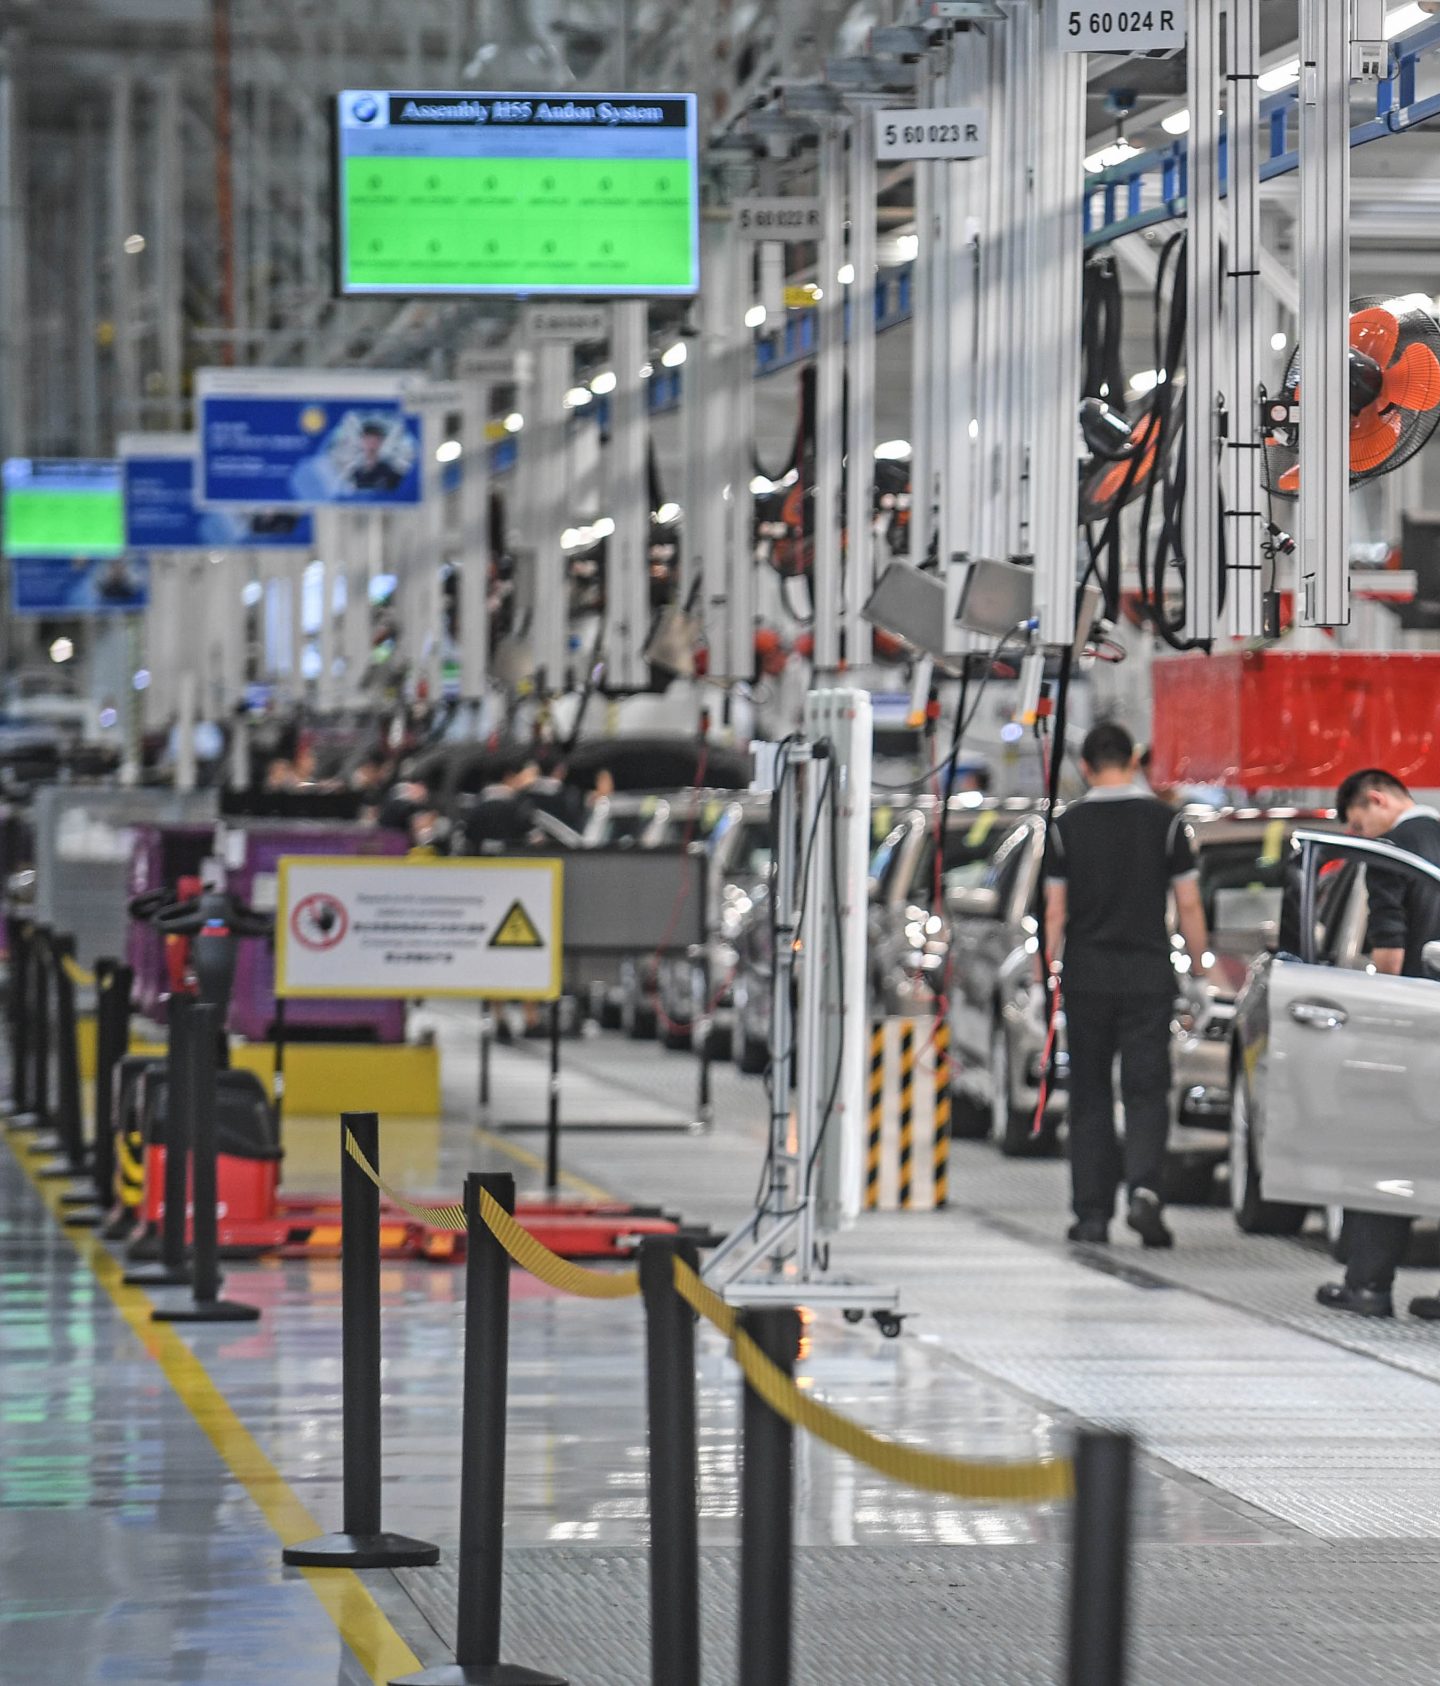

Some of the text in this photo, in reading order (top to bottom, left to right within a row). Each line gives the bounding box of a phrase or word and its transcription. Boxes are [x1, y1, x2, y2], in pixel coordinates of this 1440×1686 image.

[1068, 10, 1174, 36] 5 60 024 R
[401, 100, 489, 126] Assembly
[533, 102, 596, 123] Andon
[595, 102, 665, 127] System
[886, 124, 979, 145] 5 60 023 R
[807, 209, 819, 225] R
